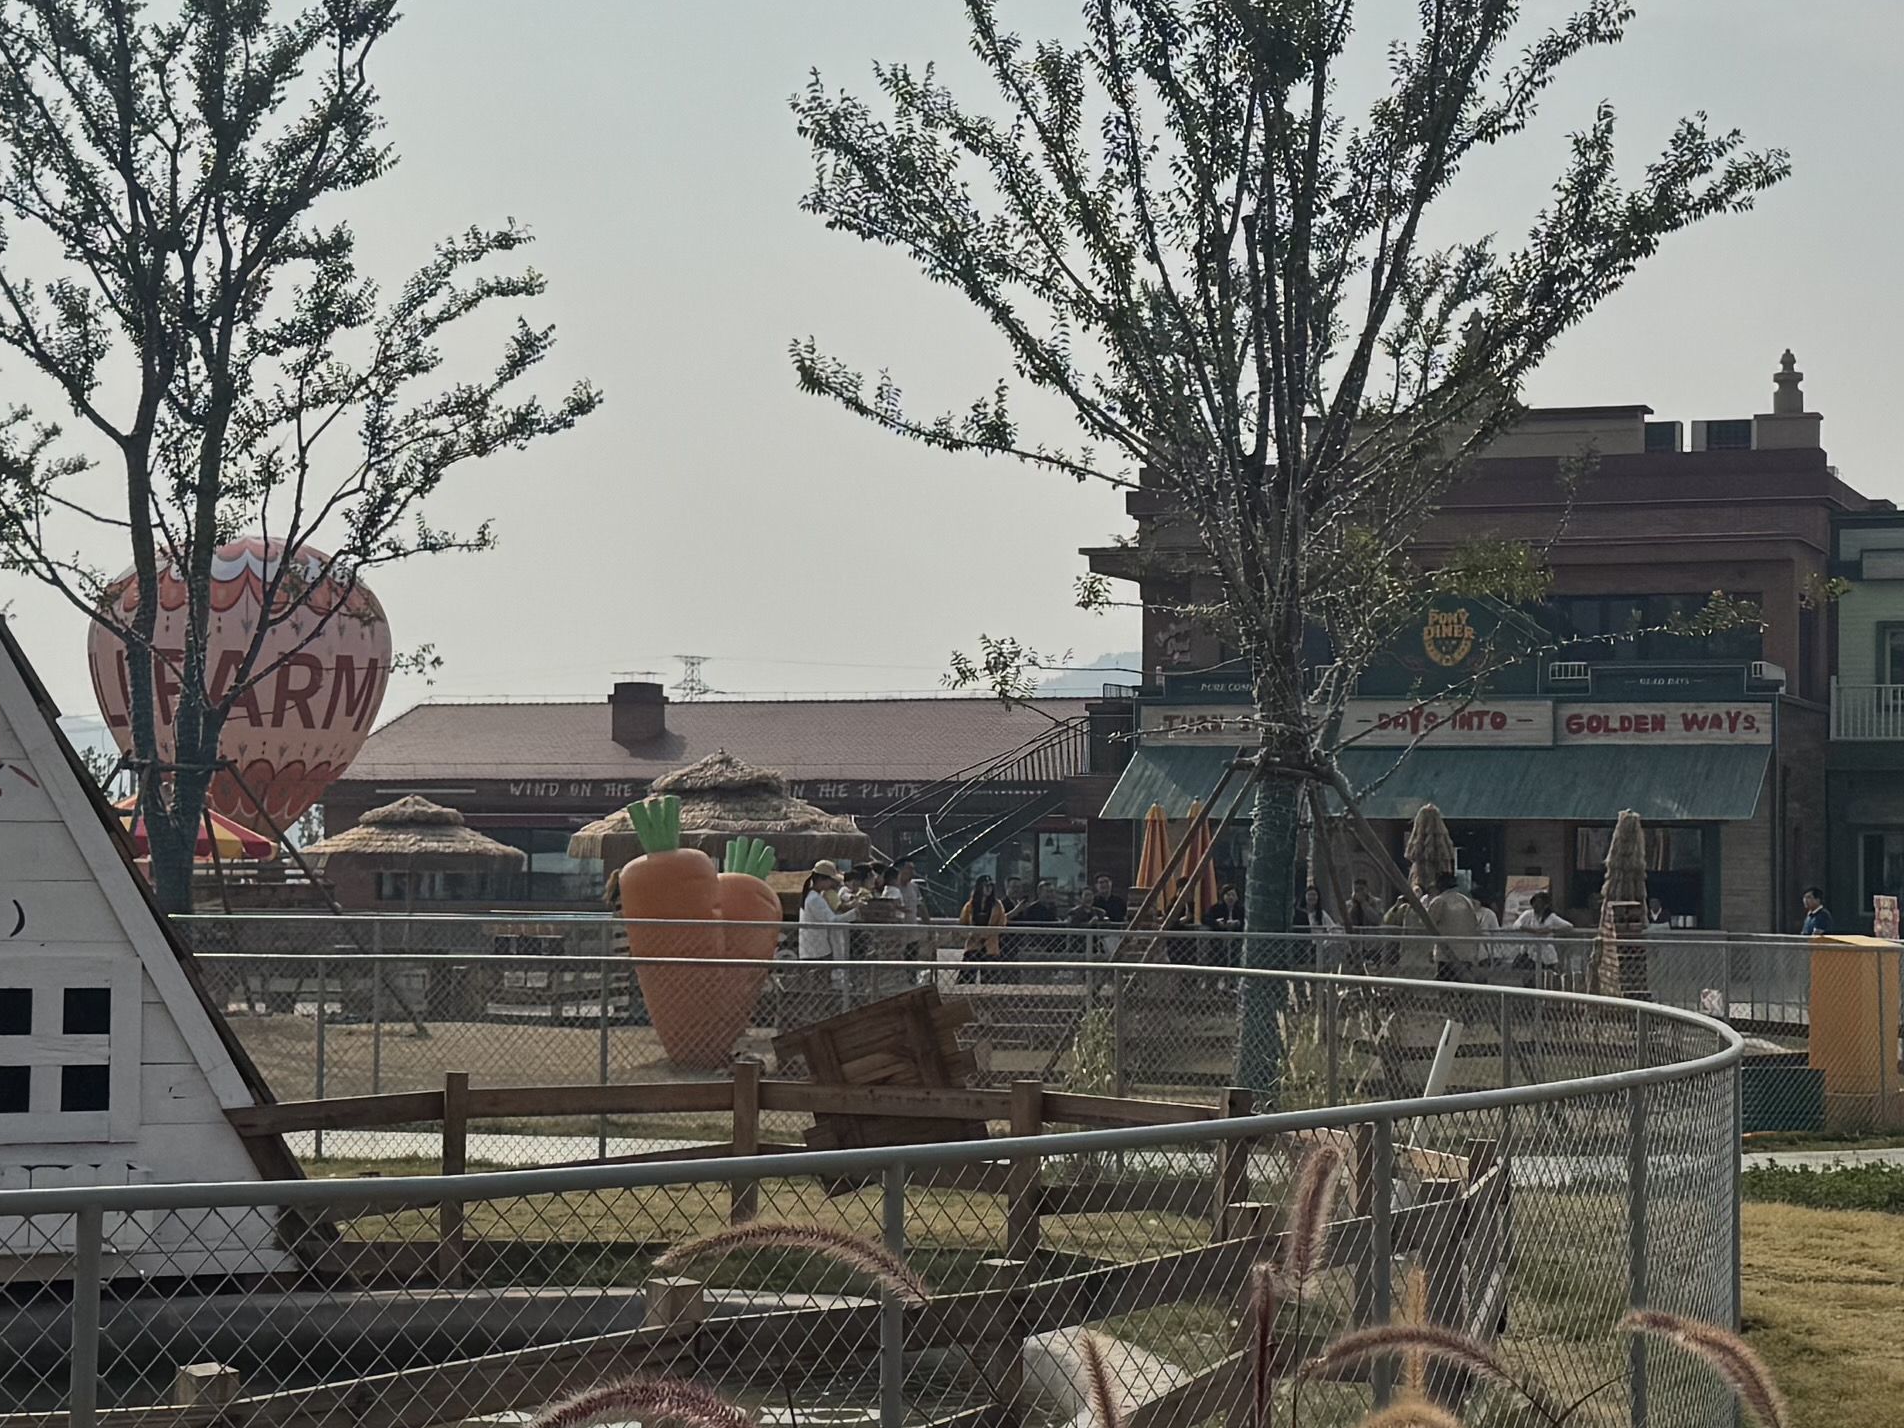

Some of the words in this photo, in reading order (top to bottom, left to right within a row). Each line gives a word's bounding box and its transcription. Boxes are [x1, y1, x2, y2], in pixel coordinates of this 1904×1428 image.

[1428, 608, 1470, 626] PONY
[1423, 624, 1476, 641] DINER
[1565, 713, 1666, 735] GOLDEN
[509, 781, 560, 797] WIND
[570, 781, 592, 797] ON
[603, 782, 633, 796] THE
[817, 783, 850, 797] THE
